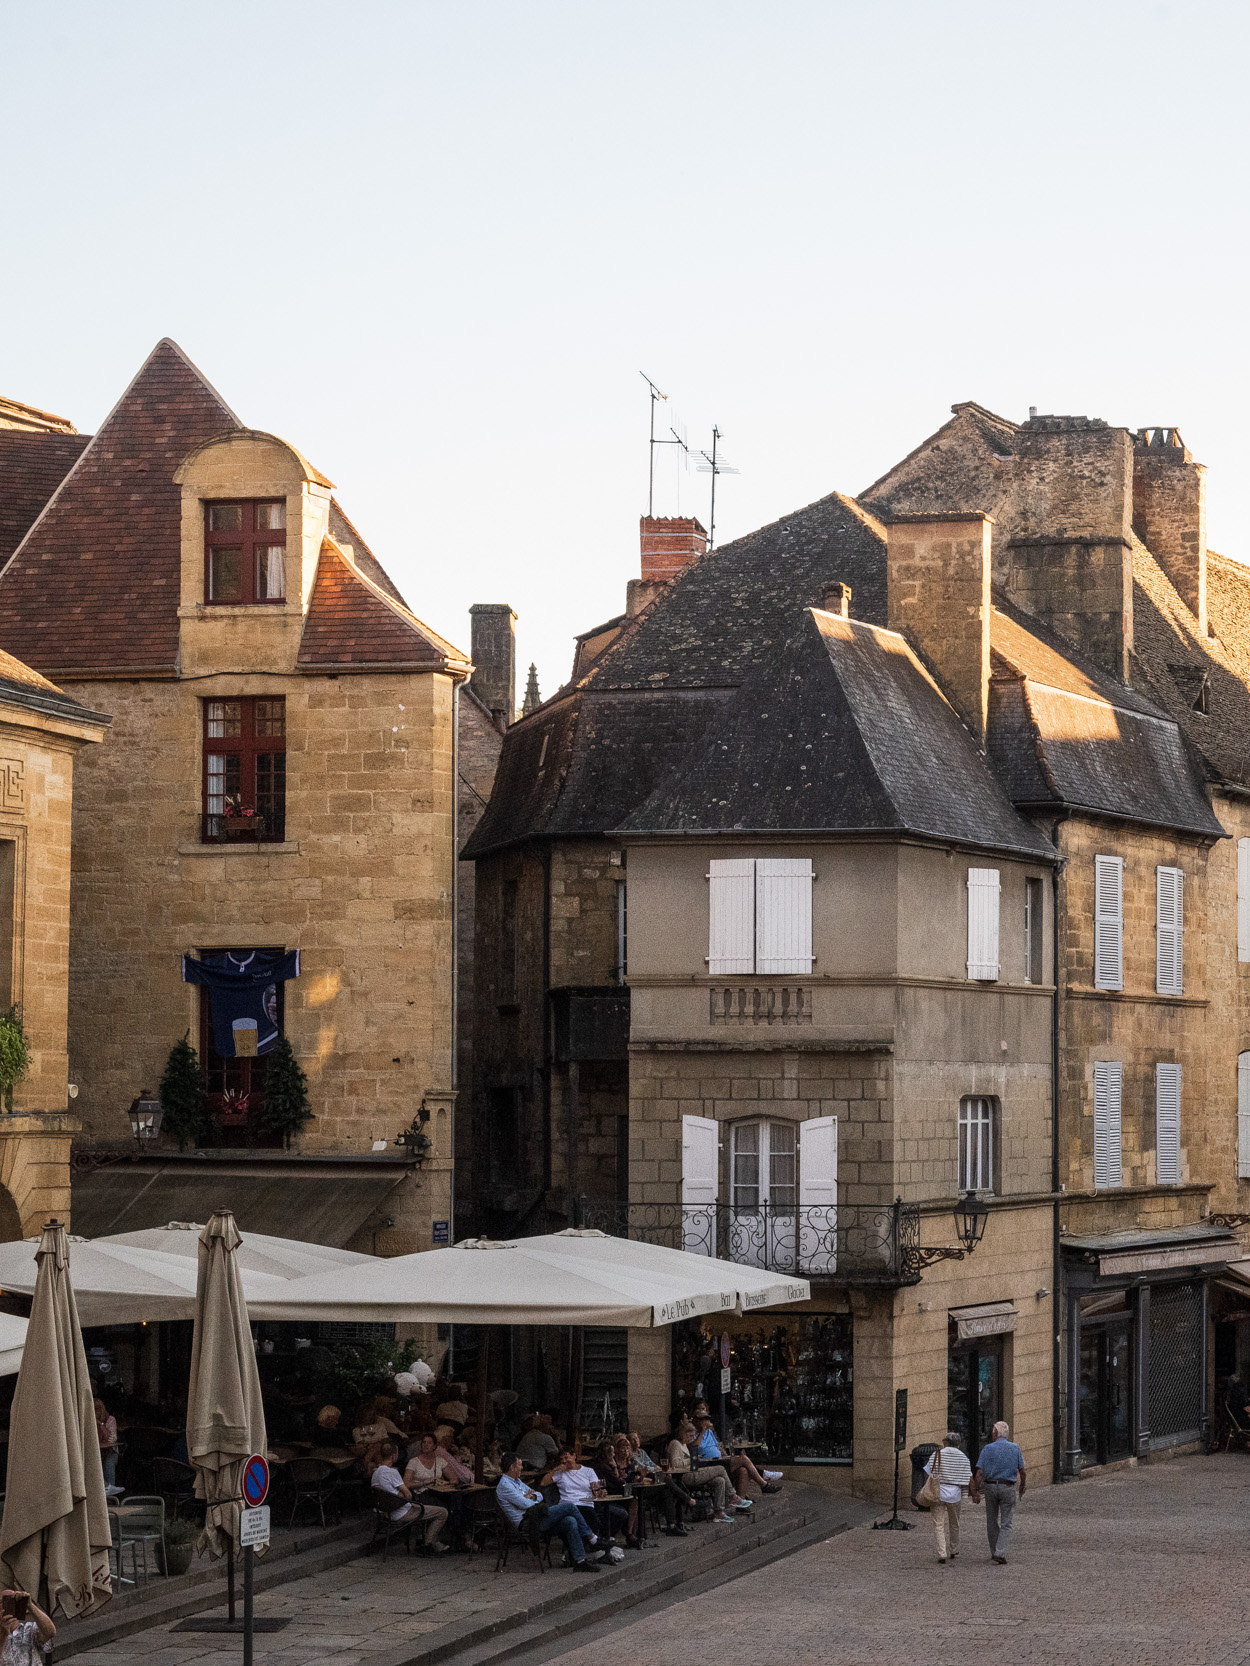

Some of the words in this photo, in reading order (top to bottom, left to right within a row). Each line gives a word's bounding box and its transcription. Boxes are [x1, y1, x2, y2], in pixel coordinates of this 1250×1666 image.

[665, 1303, 676, 1320] Le
[675, 1298, 690, 1318] Pub
[720, 1292, 731, 1307] Bar
[745, 1290, 767, 1308] Brasserie
[787, 1284, 805, 1300] Glacier
